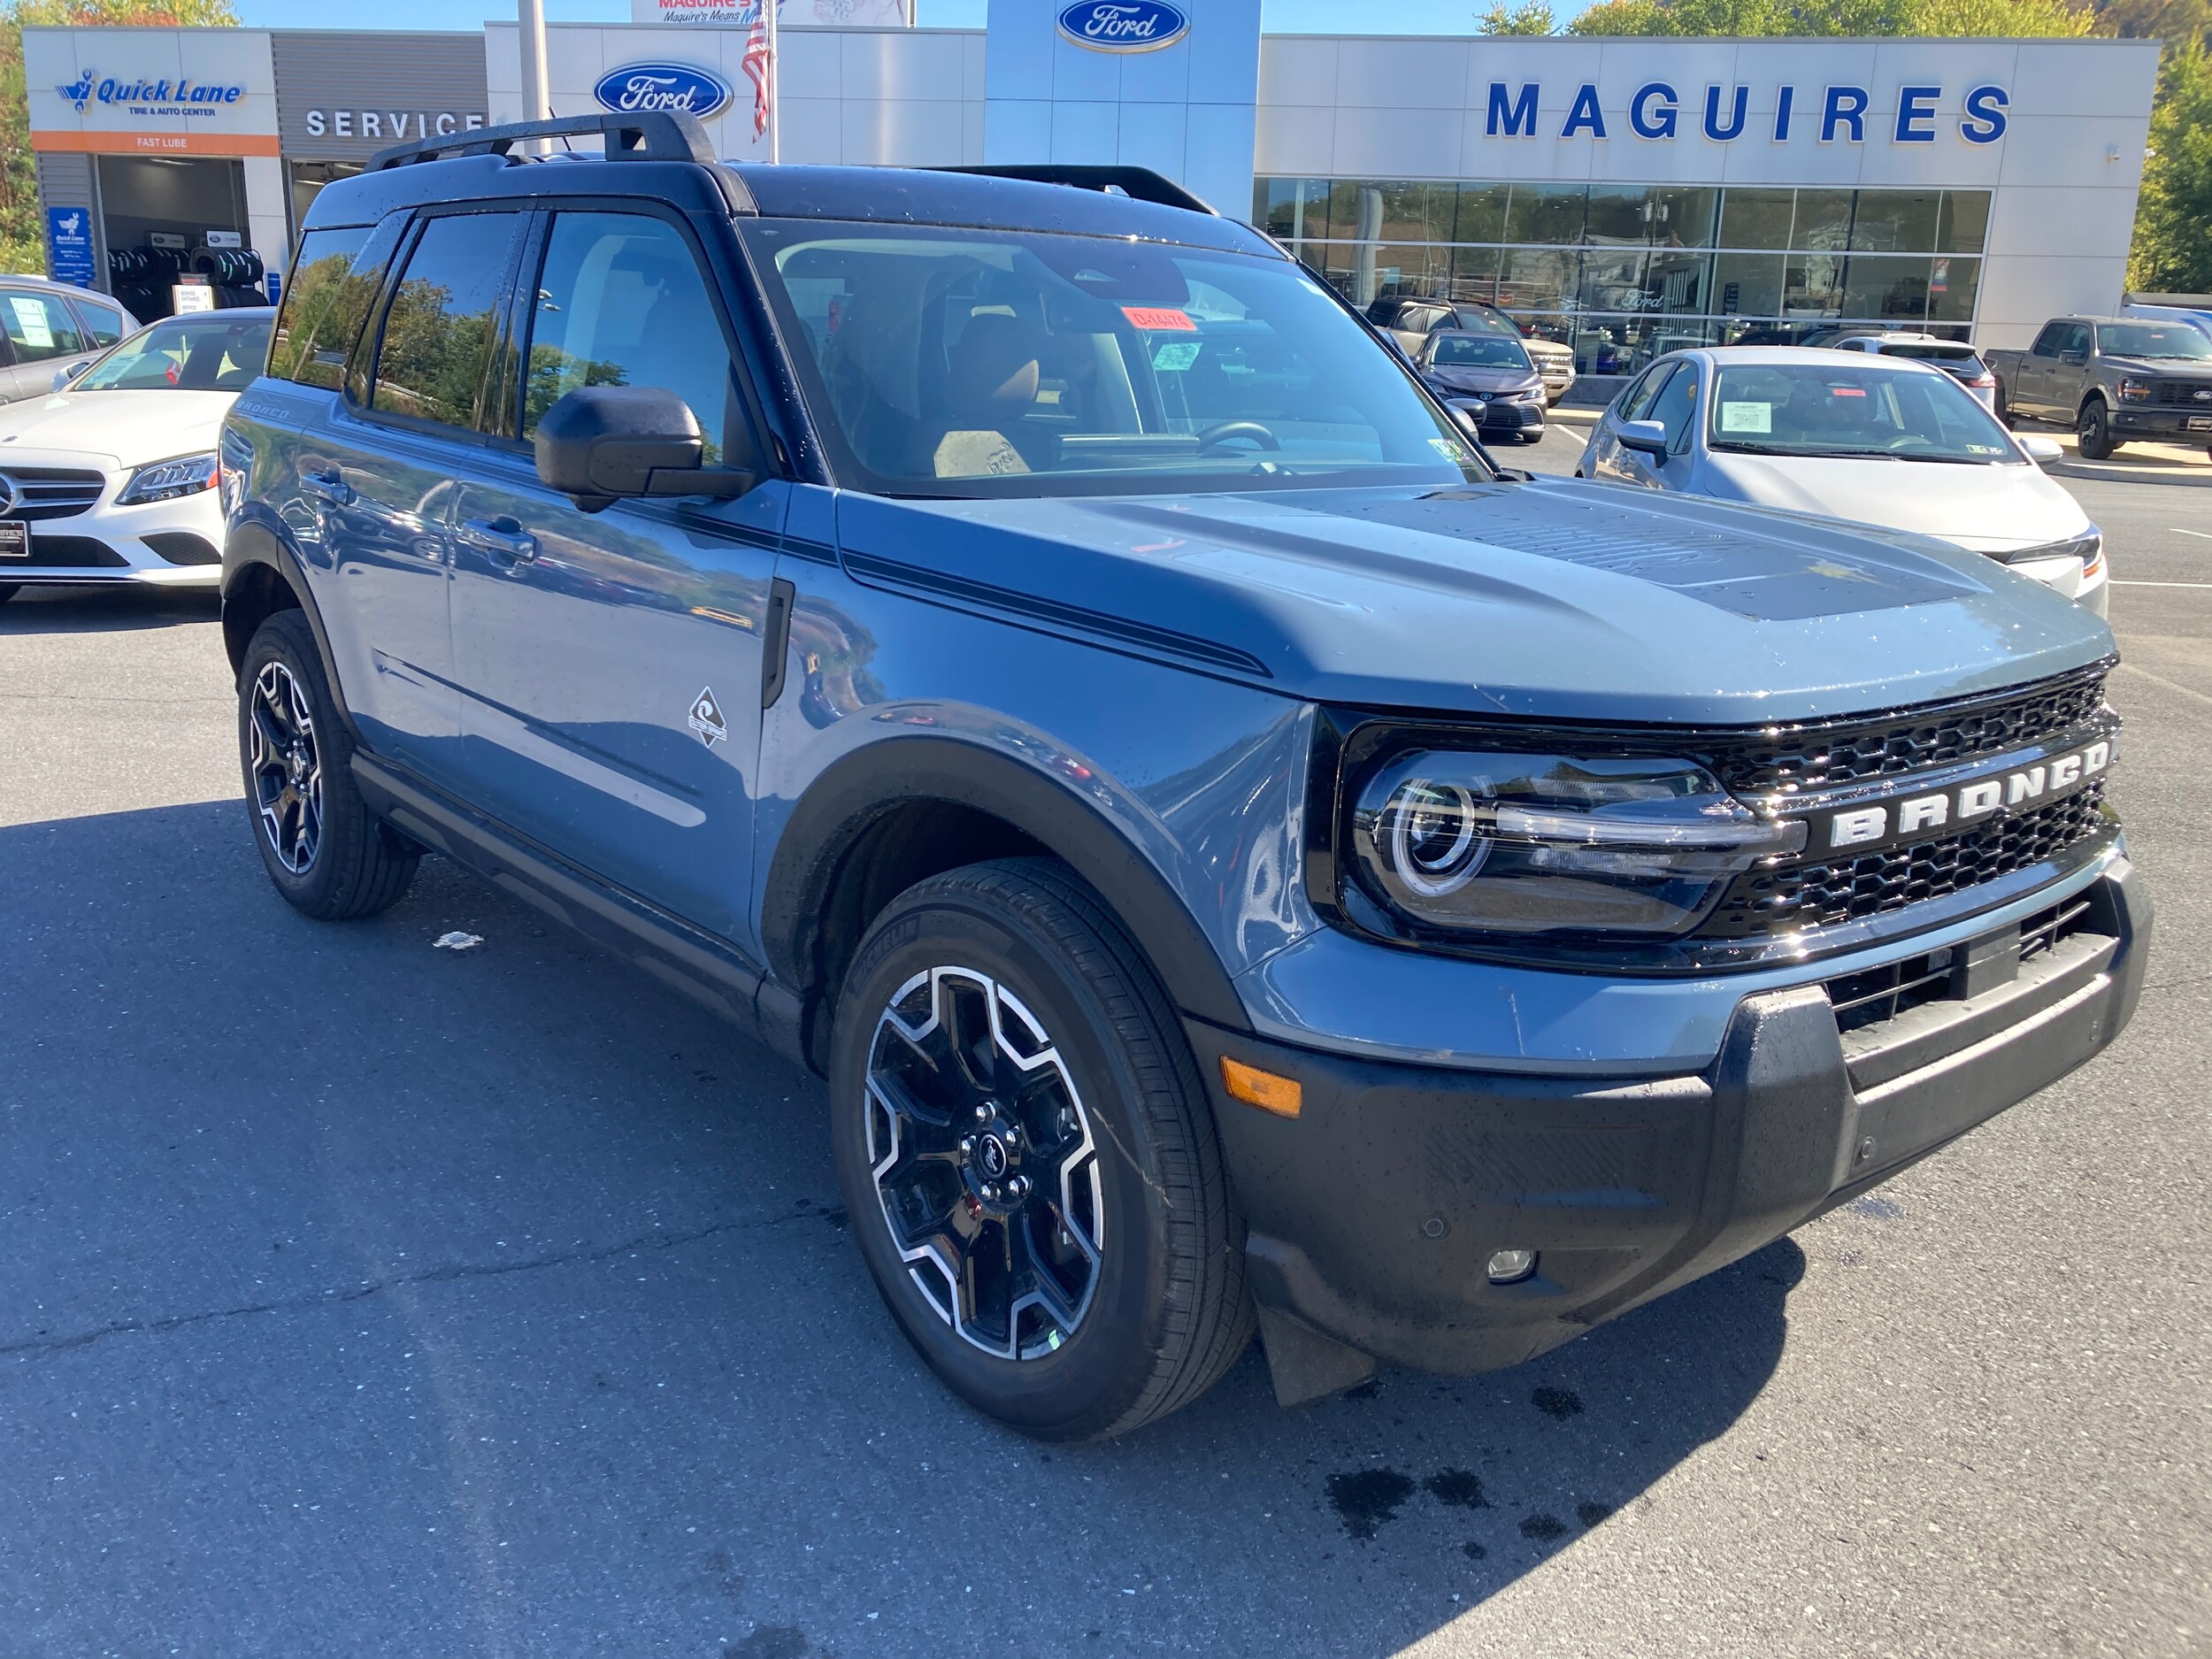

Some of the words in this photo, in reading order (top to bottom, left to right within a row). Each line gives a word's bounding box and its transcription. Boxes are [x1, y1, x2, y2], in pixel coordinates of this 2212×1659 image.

[664, 11, 708, 23] Maguire's
[710, 10, 741, 21] Means
[1085, 4, 1158, 36] Ford
[96, 78, 171, 104] Quick
[174, 79, 241, 103] Lane
[620, 75, 696, 110] Ford
[181, 108, 215, 117] CENTER
[306, 111, 482, 138] SERVICE
[1483, 81, 2011, 145] MAGUIRES
[137, 138, 160, 147] FAST
[162, 138, 188, 148] LUBE
[1622, 289, 1664, 308] Ford
[235, 401, 289, 419] BRONCO
[1831, 741, 2109, 847] BRONCO
